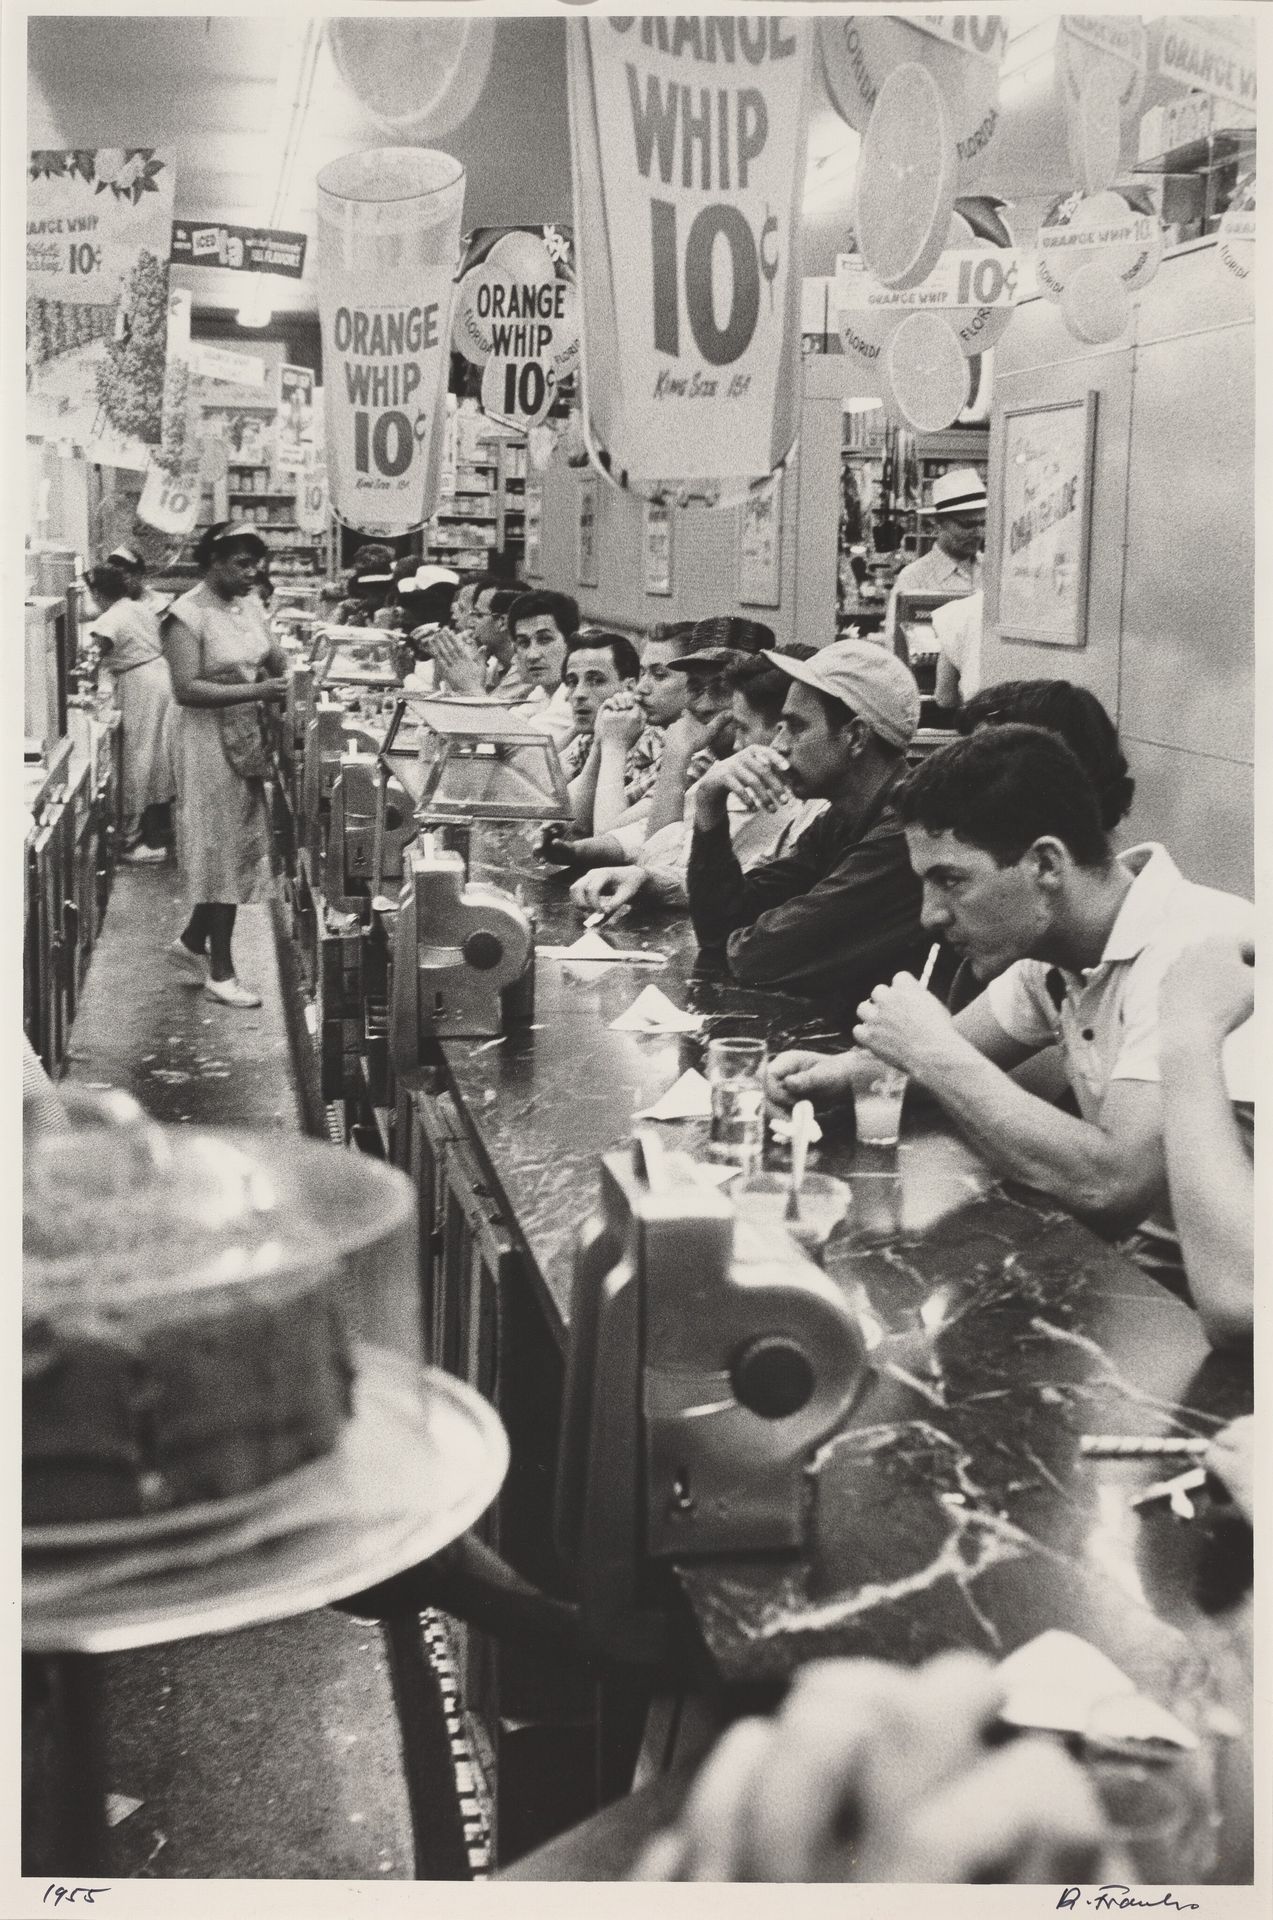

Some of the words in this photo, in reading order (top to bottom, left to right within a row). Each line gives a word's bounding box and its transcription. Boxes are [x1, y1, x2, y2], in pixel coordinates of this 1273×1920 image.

[625, 62, 769, 191] WHIP
[1042, 232, 1095, 249] ORANGE
[1100, 227, 1131, 242] WHIP
[477, 283, 567, 319] ORANGE
[650, 198, 780, 367] 10¢
[868, 293, 916, 305] ORANGE
[919, 291, 949, 304] WHIP
[957, 258, 1019, 305] 10¢
[334, 302, 439, 357] ORANGE
[491, 323, 553, 358] WHIP
[345, 361, 422, 407] WHIP
[504, 361, 556, 416] 10¢
[354, 408, 427, 478] 10¢
[42, 1883, 113, 1907] 1955
